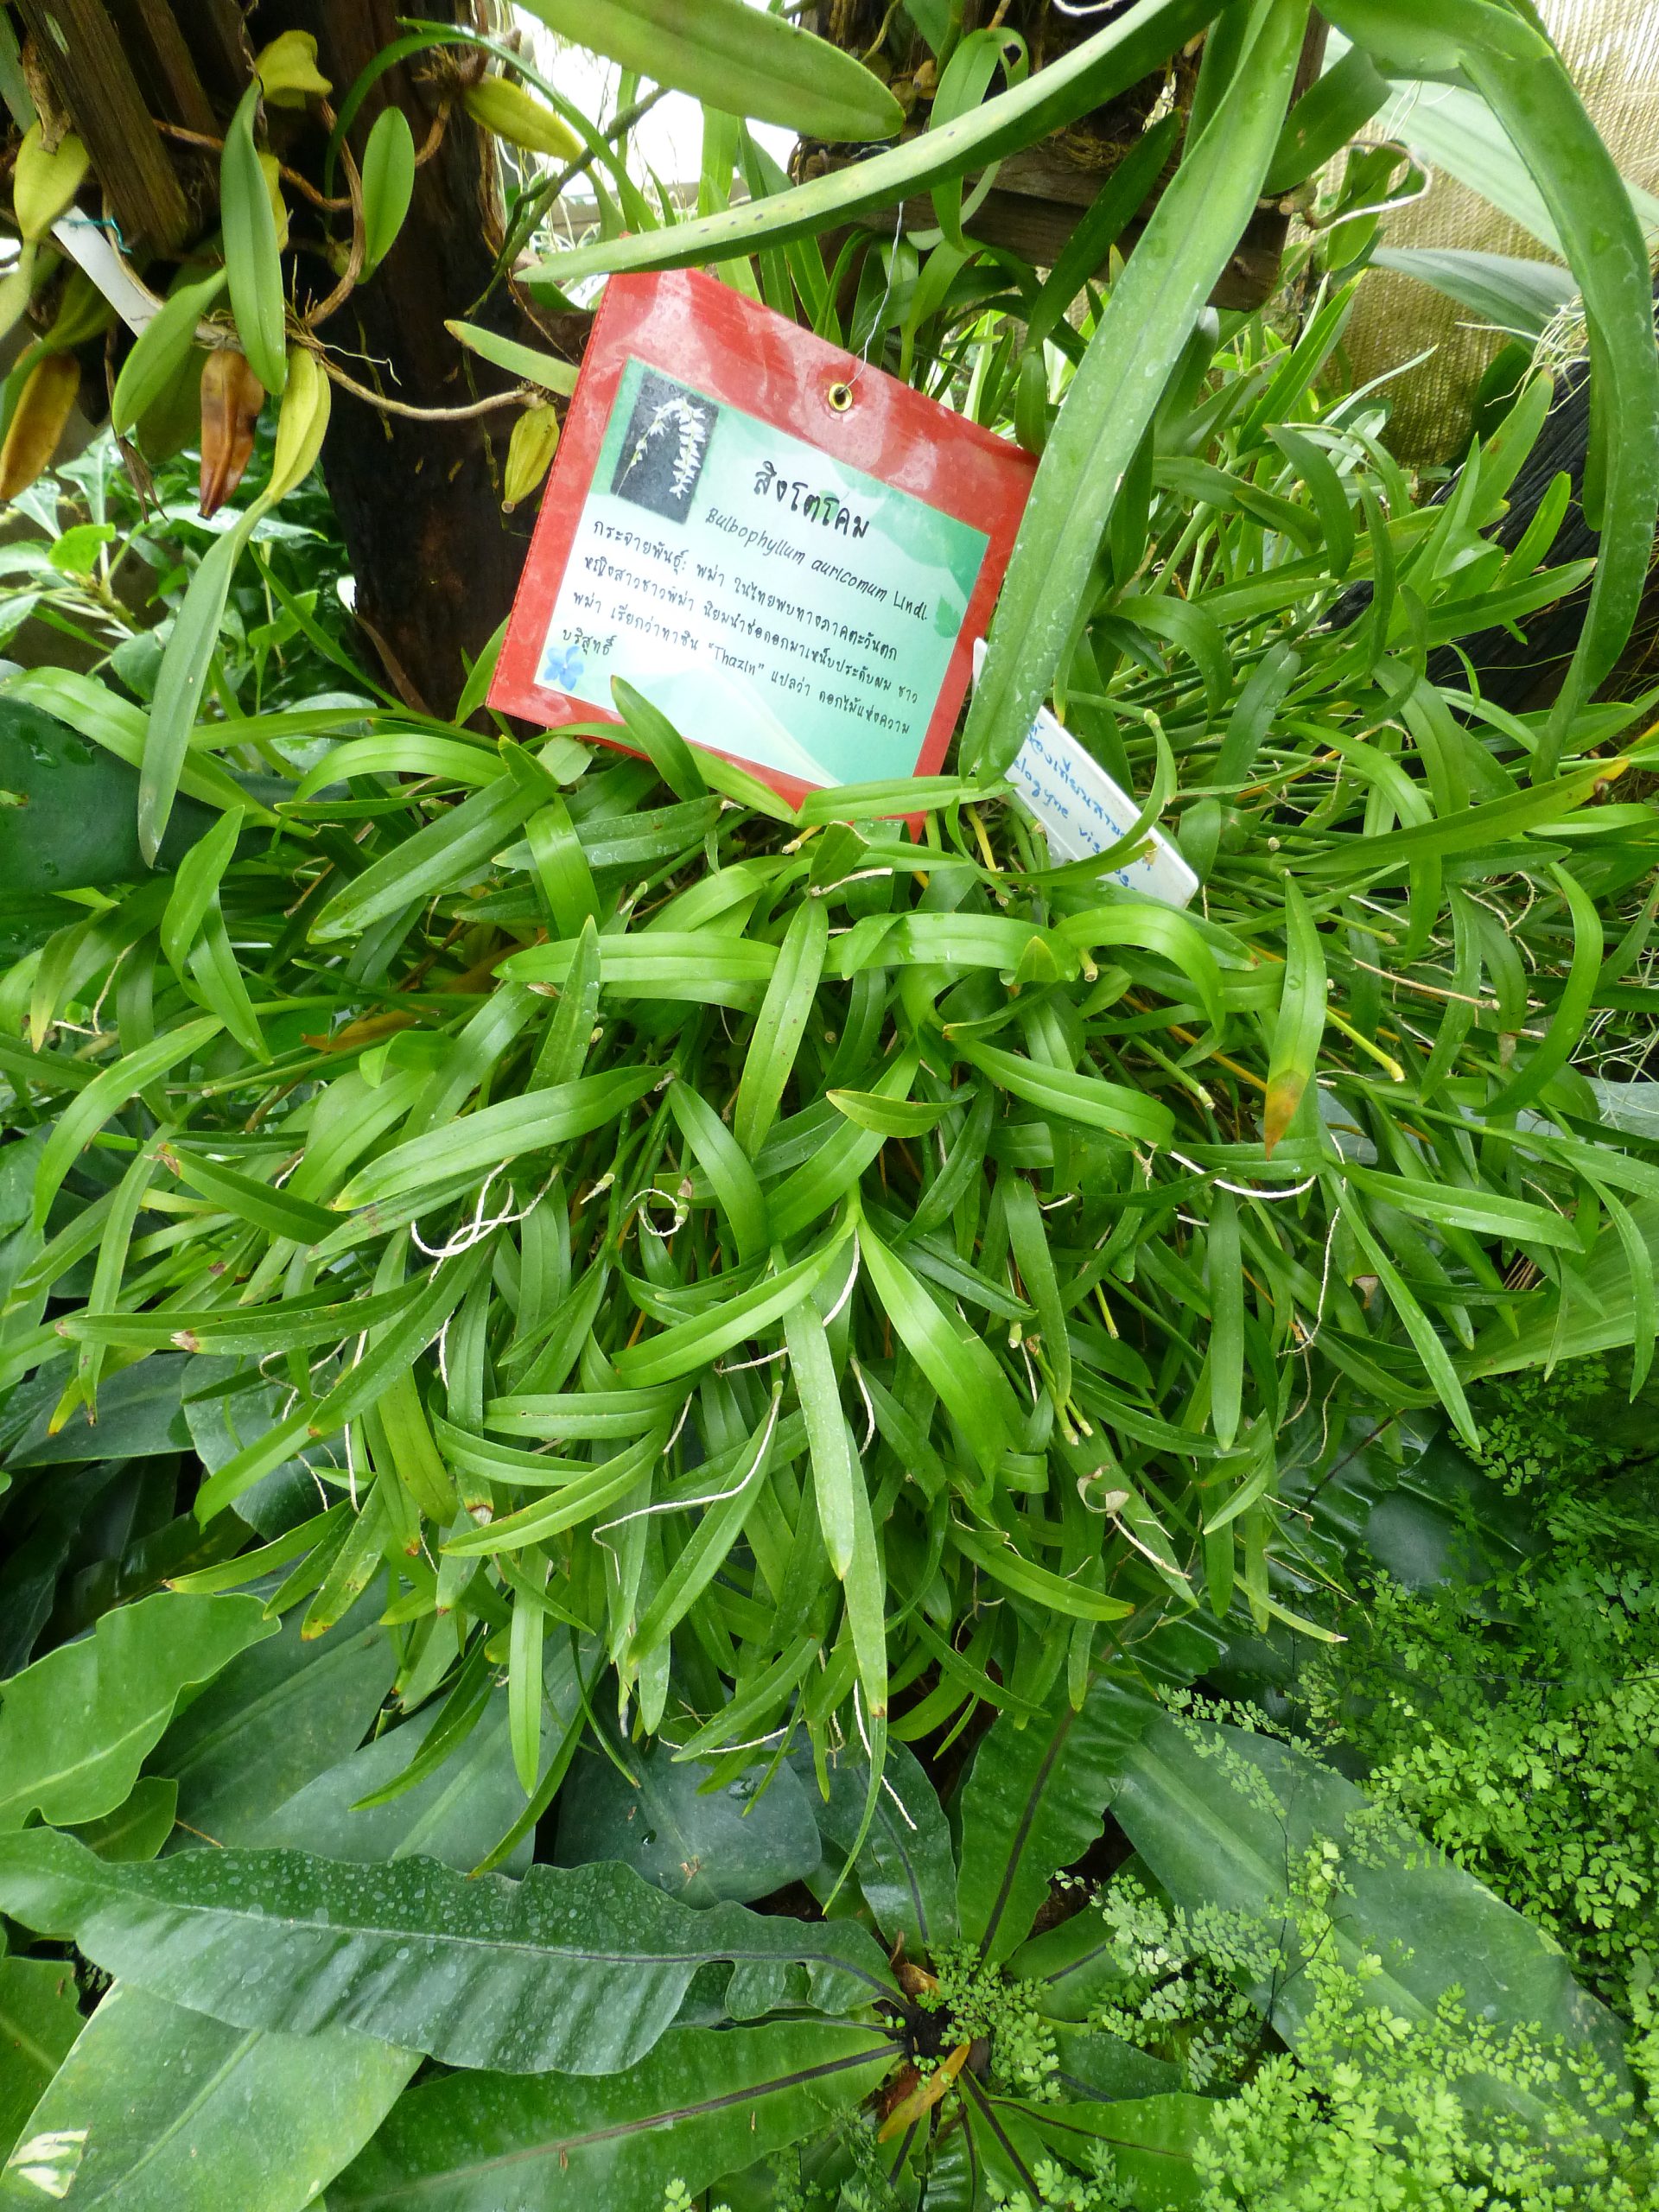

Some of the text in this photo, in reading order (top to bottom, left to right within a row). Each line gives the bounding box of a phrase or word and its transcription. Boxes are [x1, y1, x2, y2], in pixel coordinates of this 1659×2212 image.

[705, 508, 805, 565] Bulbophyllum
[811, 560, 887, 602] auricomum
[1013, 757, 1068, 819] elogyne
